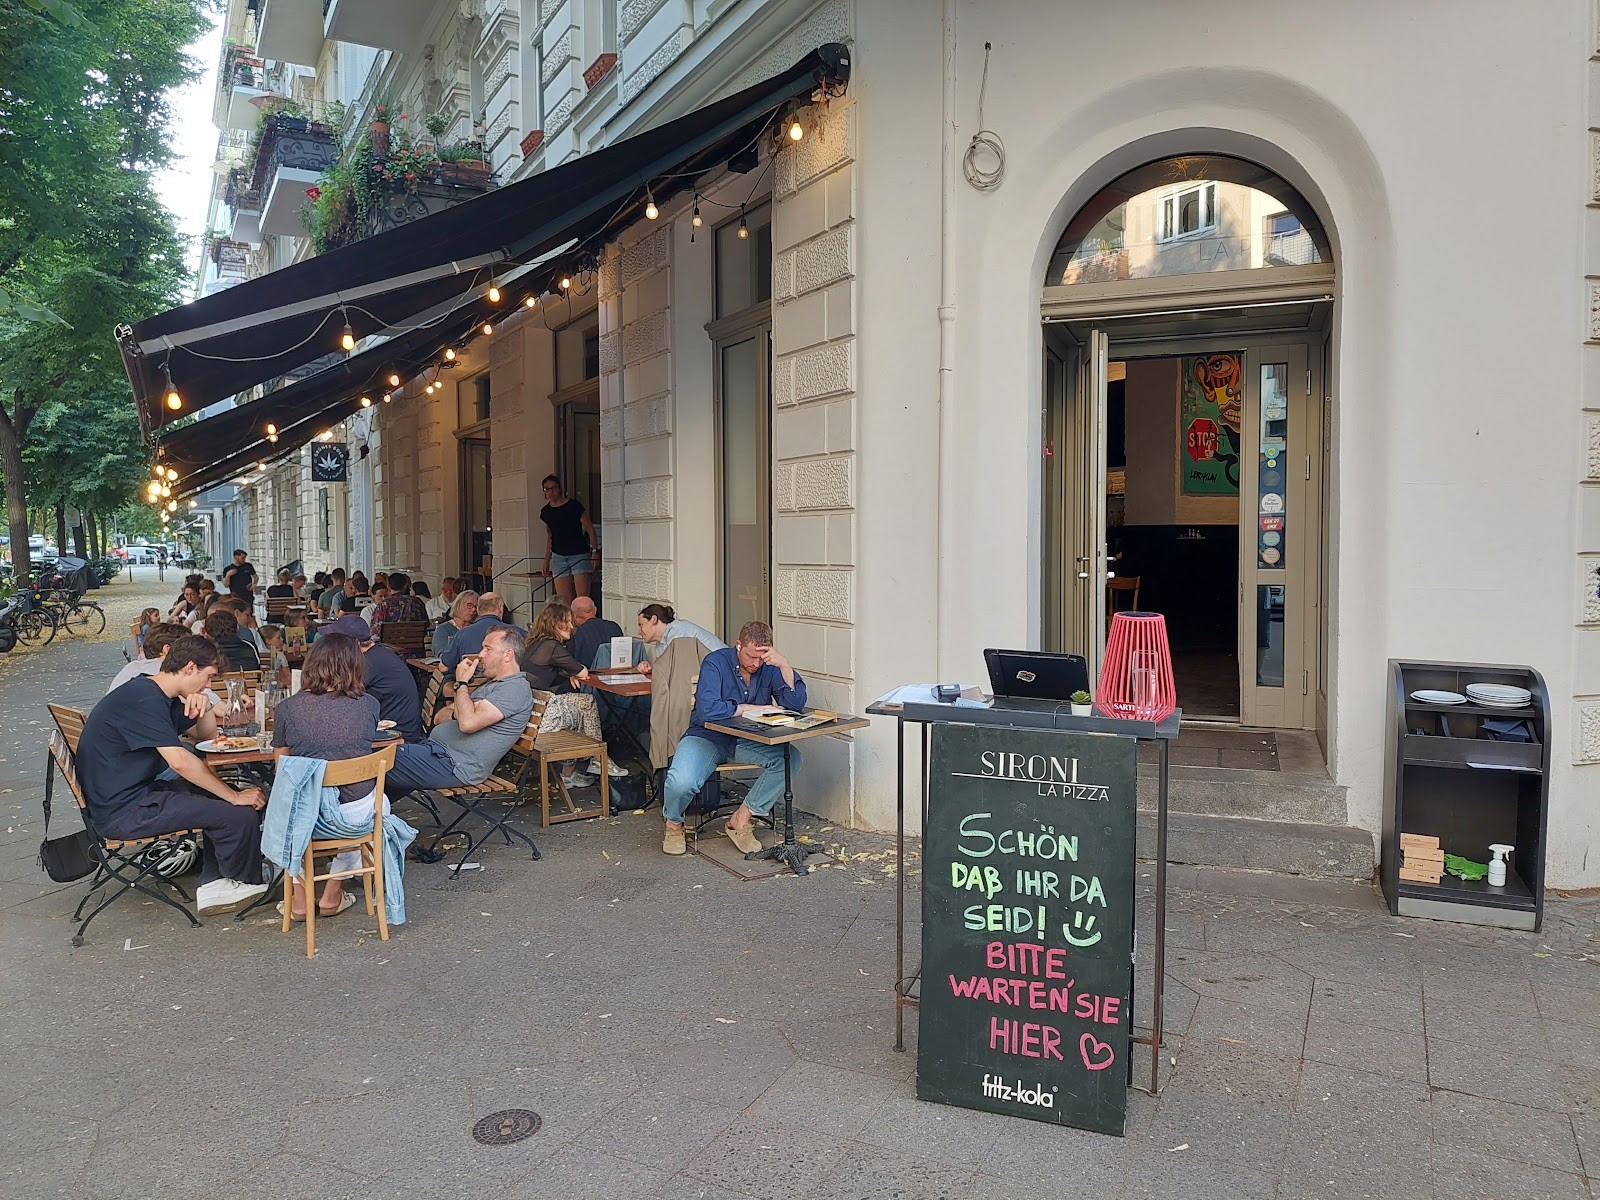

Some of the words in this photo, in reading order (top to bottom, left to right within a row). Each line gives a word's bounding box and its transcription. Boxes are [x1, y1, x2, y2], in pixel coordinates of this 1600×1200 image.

[981, 750, 1079, 783] SIRONI
[1037, 783, 1057, 797] LA
[1063, 785, 1110, 802] PIZZA
[957, 812, 1079, 862] SCHÖN
[1016, 869, 1060, 899] IHR
[1070, 874, 1108, 908] DA
[963, 904, 1046, 940] SEID!
[1074, 993, 1121, 1024] SIE
[989, 1016, 1064, 1061] HIER
